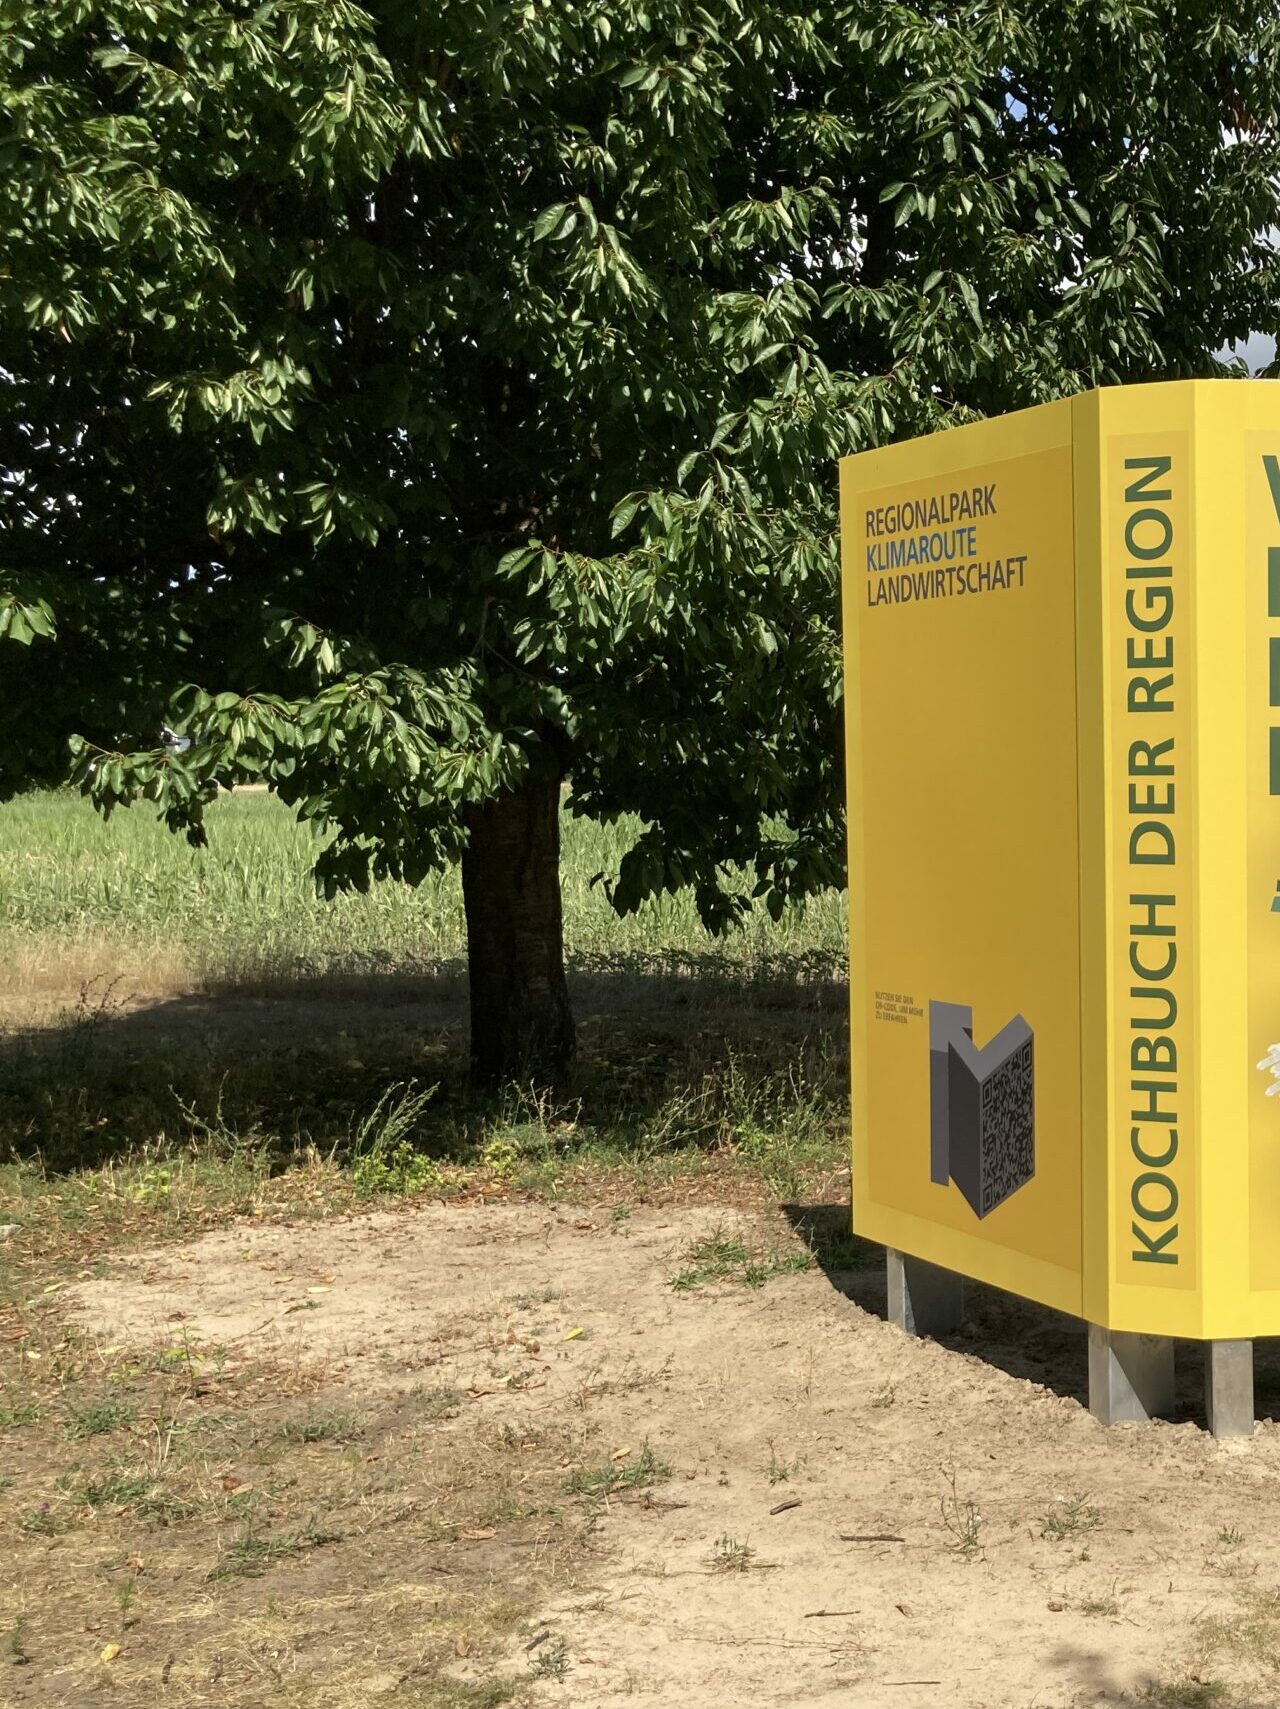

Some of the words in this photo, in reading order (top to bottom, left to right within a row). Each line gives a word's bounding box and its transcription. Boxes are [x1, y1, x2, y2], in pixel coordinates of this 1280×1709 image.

[866, 484, 997, 538] REGIONALPARK
[867, 526, 977, 572] KLIMAROUTE
[868, 556, 1028, 607] LANDWIRTSCHAFT
[1125, 456, 1174, 712] REGION
[1128, 737, 1176, 866] DER
[1129, 894, 1179, 1265] KOCHBUCH
